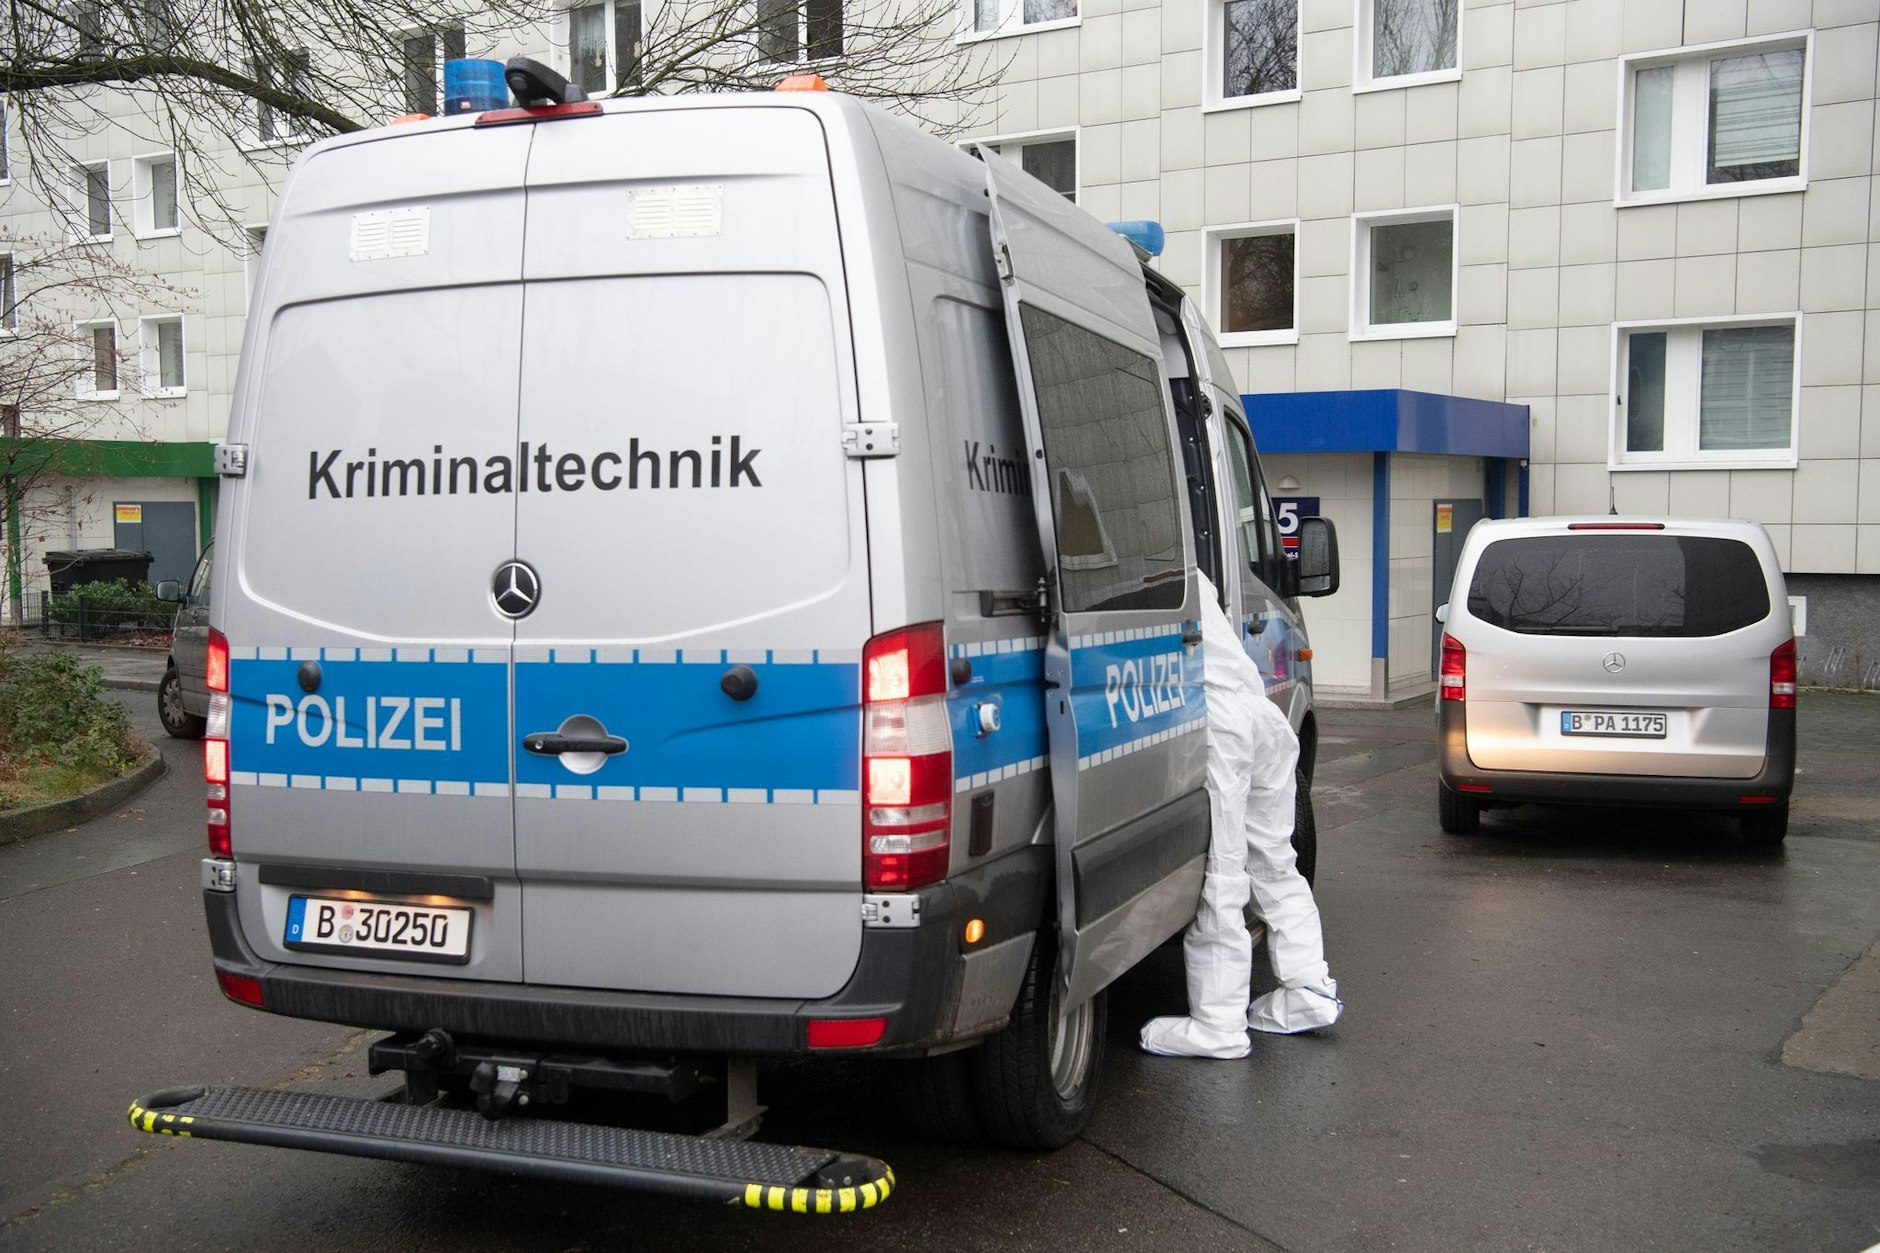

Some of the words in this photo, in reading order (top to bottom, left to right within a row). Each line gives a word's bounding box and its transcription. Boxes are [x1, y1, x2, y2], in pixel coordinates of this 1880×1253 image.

[309, 435, 762, 499] Kriminaltechnik
[1278, 502, 1298, 534] 5
[1105, 651, 1186, 728] POLIZEI
[265, 693, 461, 751] POLIZEI
[1572, 715, 1582, 730] B
[1594, 715, 1616, 731] PA
[1621, 716, 1664, 732] 1175
[292, 924, 299, 934] D
[317, 905, 335, 938] B
[355, 908, 448, 947] 30250
